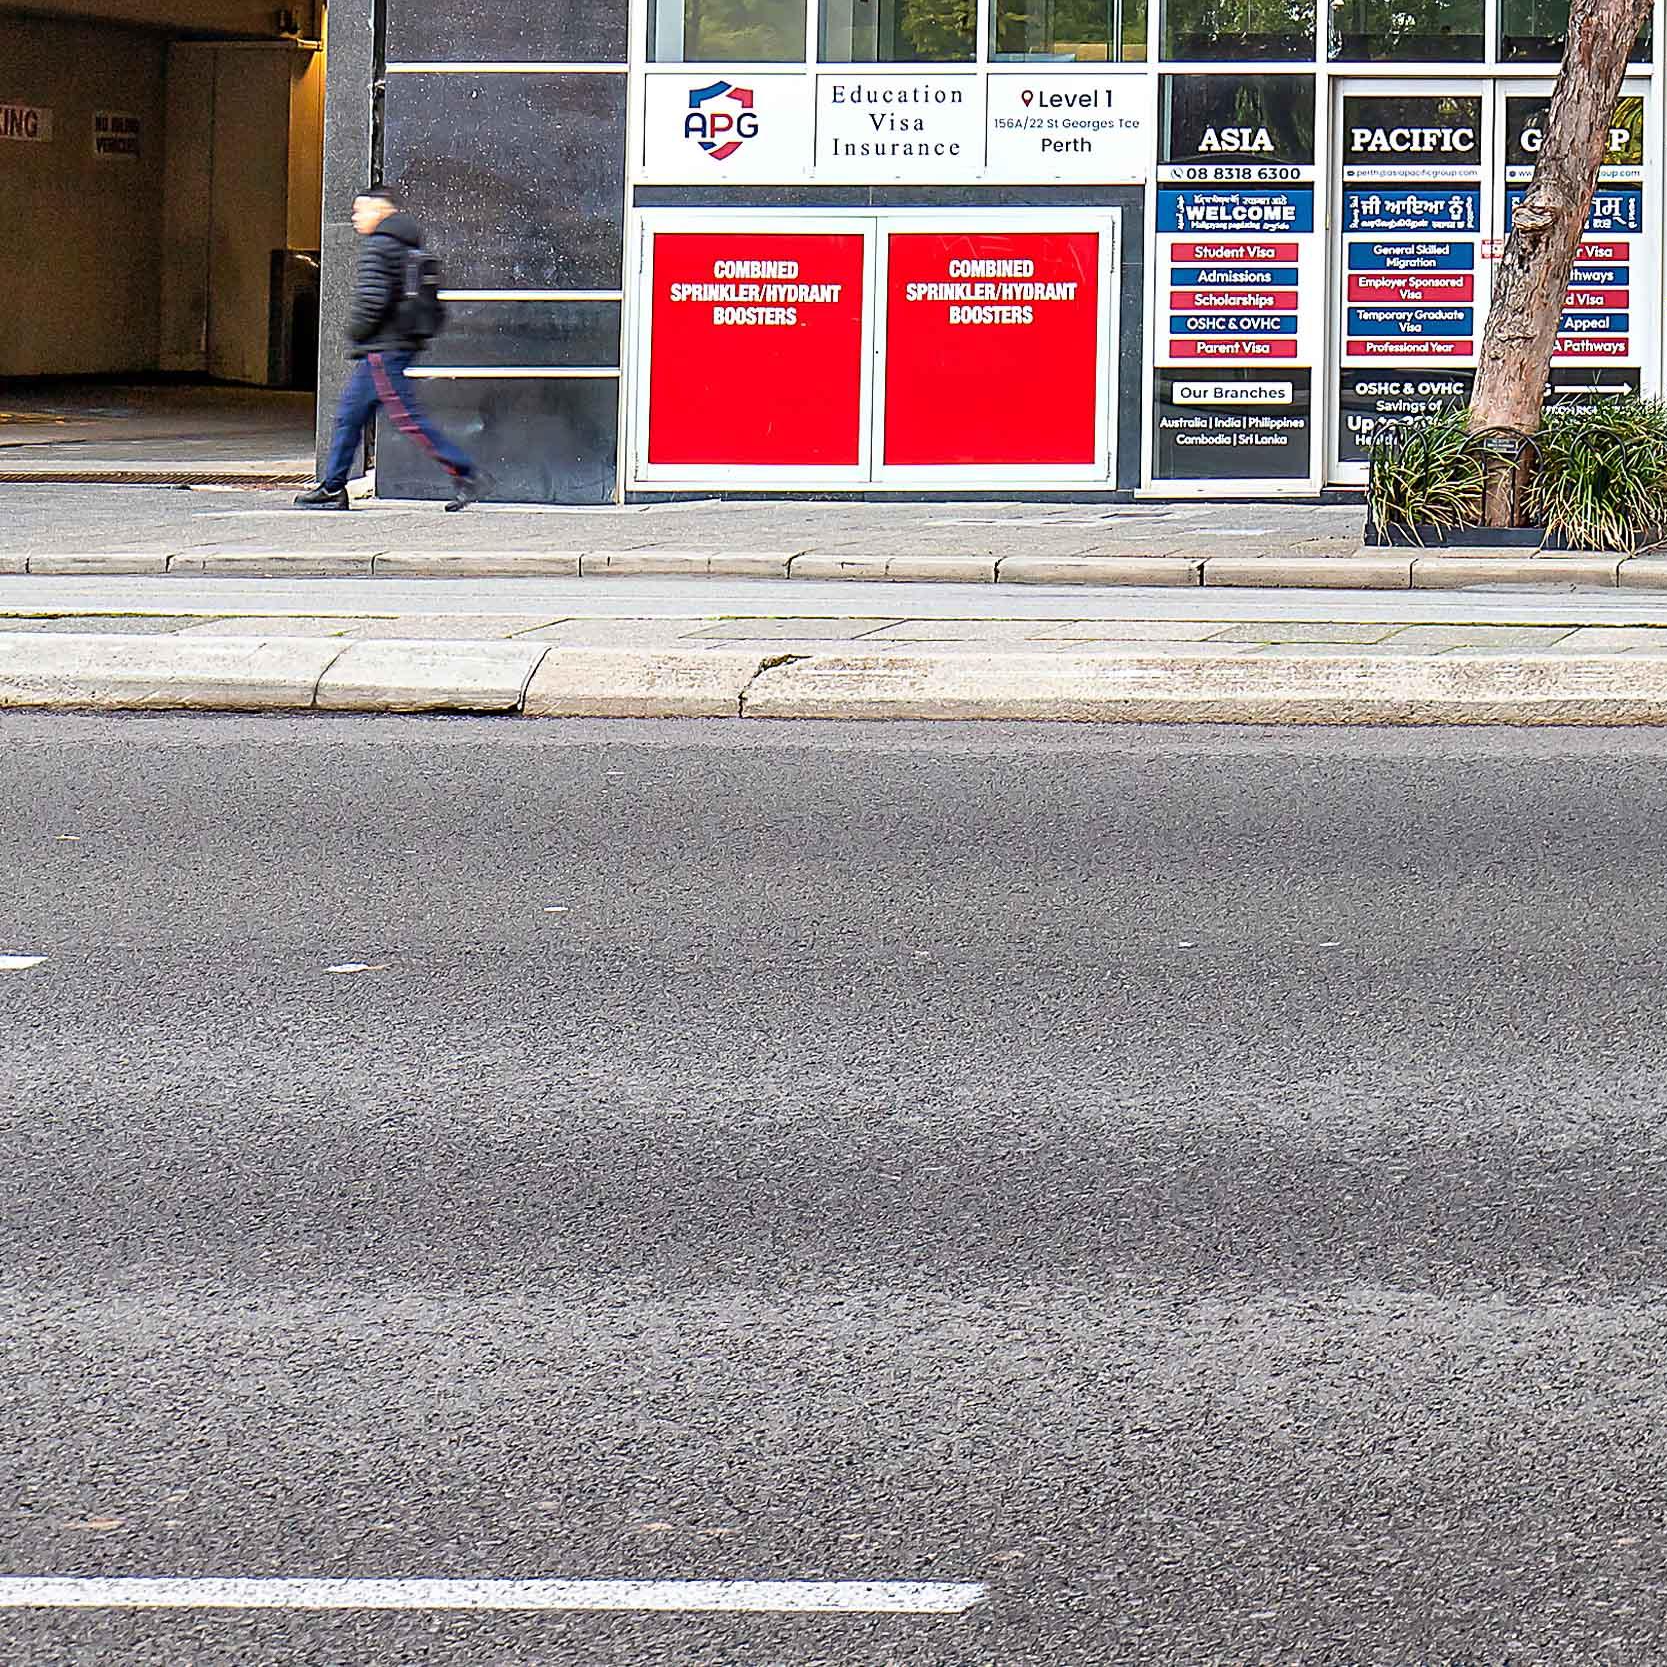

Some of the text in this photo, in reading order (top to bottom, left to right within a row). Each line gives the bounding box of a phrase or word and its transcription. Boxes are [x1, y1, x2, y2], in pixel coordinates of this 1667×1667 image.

[832, 84, 962, 104] Education
[1039, 89, 1112, 108] Level 1
[0, 107, 38, 138] ING
[685, 112, 759, 138] APG
[868, 113, 924, 132] Visa
[994, 116, 1140, 132] 156A/22 St Georges Tce
[832, 137, 961, 156] Insurance
[1041, 137, 1092, 153] Perth
[1198, 127, 1475, 152] ASIA PACIFIC
[1186, 167, 1301, 180] 08 8318 6300
[1186, 206, 1296, 221] WELCOME
[1194, 246, 1275, 258] Student Visa
[1373, 244, 1450, 255] General Skilled
[1585, 245, 1613, 258] Visa
[713, 260, 799, 279] COMBINED
[949, 259, 1034, 278] COMBINED
[1386, 257, 1437, 269] Migration
[1197, 269, 1272, 283] Admissions
[1358, 276, 1464, 289] Employer Sponsored
[1569, 268, 1615, 284] thways
[670, 283, 842, 303] SPRINKLER/HYDRANT
[906, 282, 1077, 301] SPRINKLER/HYDRANT
[1399, 289, 1423, 300] Visa
[1194, 293, 1275, 309] Scholarships
[1576, 293, 1604, 306] Visa
[713, 306, 797, 326] BOOSTERS
[950, 305, 1034, 325] BOOSTERS
[1357, 309, 1465, 322] Temporary Graduate
[1187, 317, 1281, 330] OSHC & OVHC
[1399, 322, 1423, 333] Visa
[1564, 316, 1610, 331] Appeal
[1197, 341, 1270, 354] Parent Visa
[1366, 342, 1455, 353] Professional Year
[1563, 339, 1626, 355] Pathways
[1180, 386, 1286, 399] Our Branches
[1355, 382, 1465, 396] OSHC & OVHC
[1375, 399, 1443, 414] Savings of
[1160, 417, 1207, 429] Australia
[1214, 417, 1242, 428] India
[1249, 417, 1305, 431] Philippines
[1347, 415, 1375, 434] Up
[1176, 434, 1232, 446] Cambodia
[1238, 434, 1254, 445] Sri
[1254, 434, 1288, 445] Lanka
